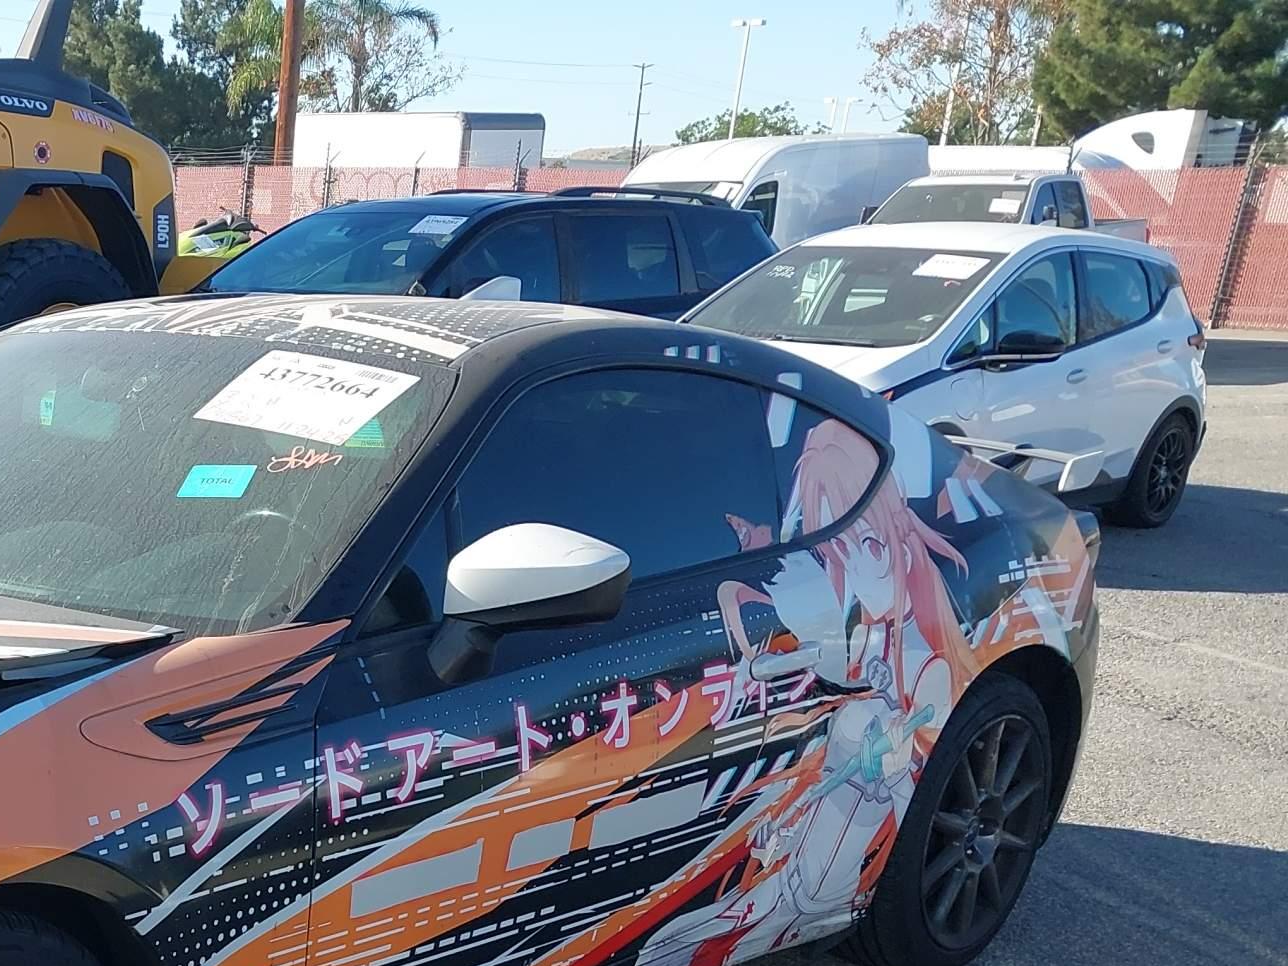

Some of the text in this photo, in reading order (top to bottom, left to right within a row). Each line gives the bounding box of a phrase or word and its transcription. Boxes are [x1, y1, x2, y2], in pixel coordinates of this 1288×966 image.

[157, 214, 170, 249] L90H
[260, 367, 381, 399] 43772664
[200, 477, 234, 486] TOTAL
